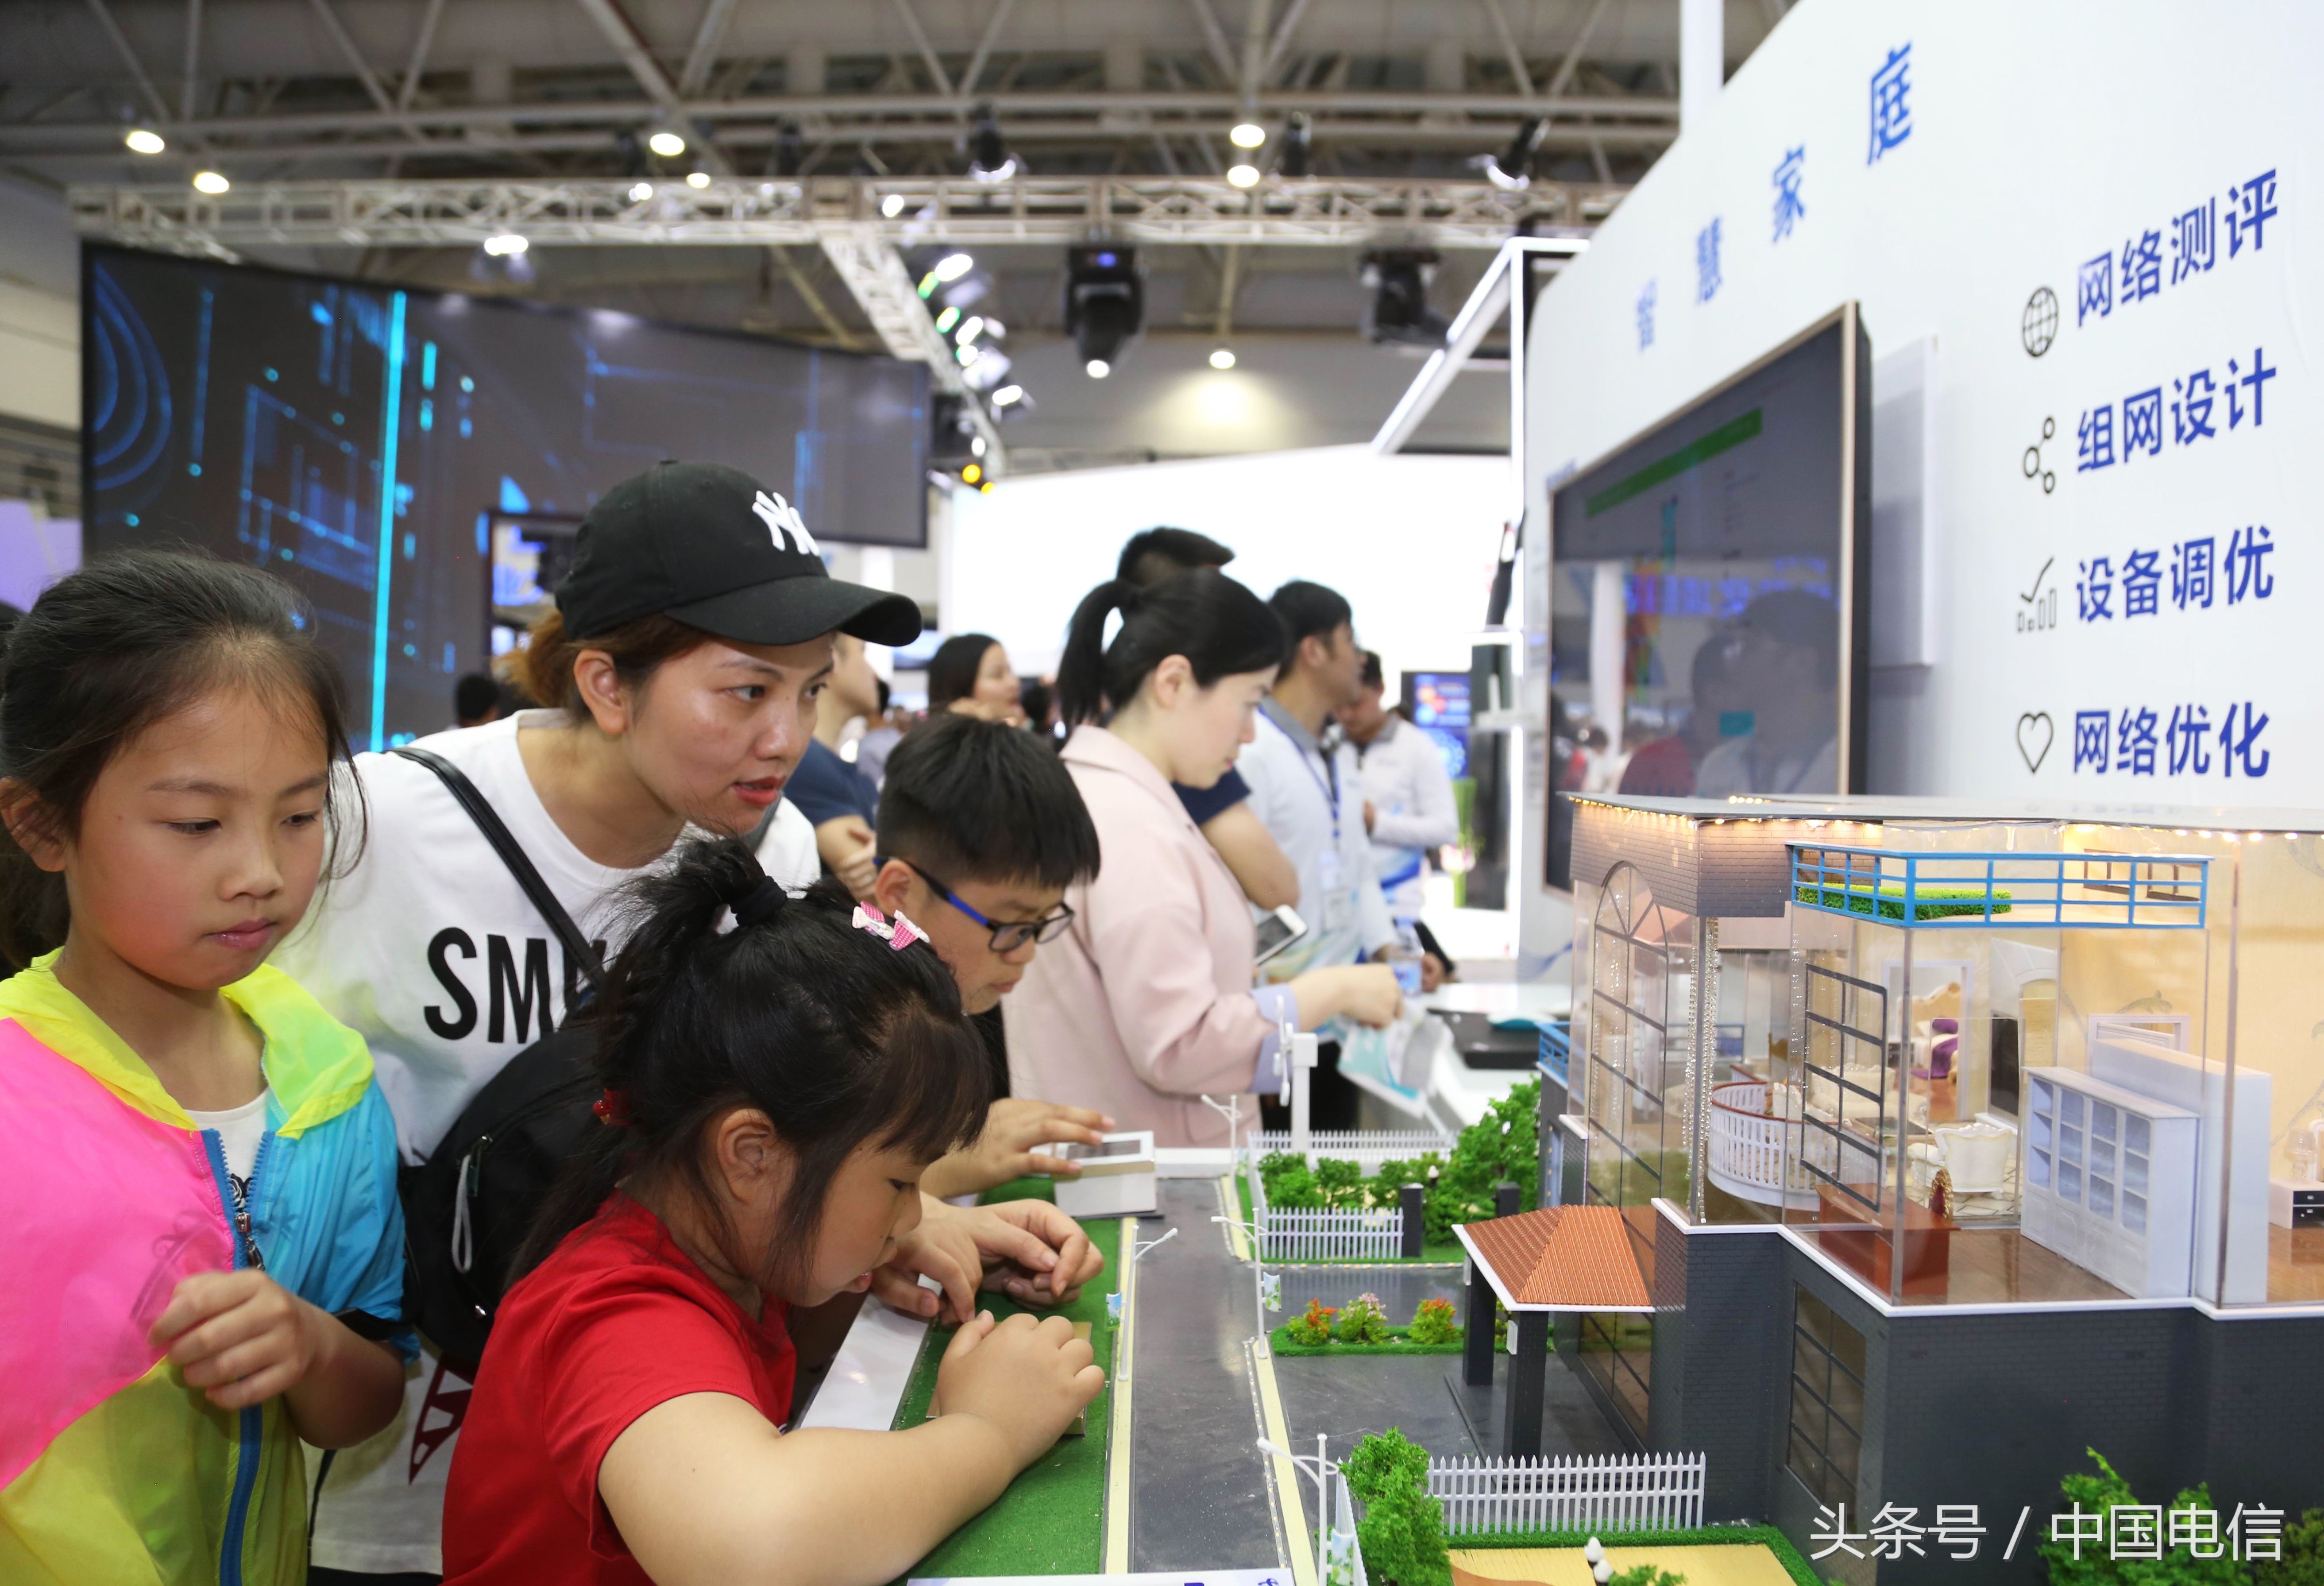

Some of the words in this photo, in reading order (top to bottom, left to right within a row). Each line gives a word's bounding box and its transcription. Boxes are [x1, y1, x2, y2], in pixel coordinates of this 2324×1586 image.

[2078, 169, 2278, 327] 网络测评
[2077, 348, 2276, 472] 组网设计
[2077, 526, 2274, 622] 设备调优
[2074, 702, 2270, 778] 网络优化
